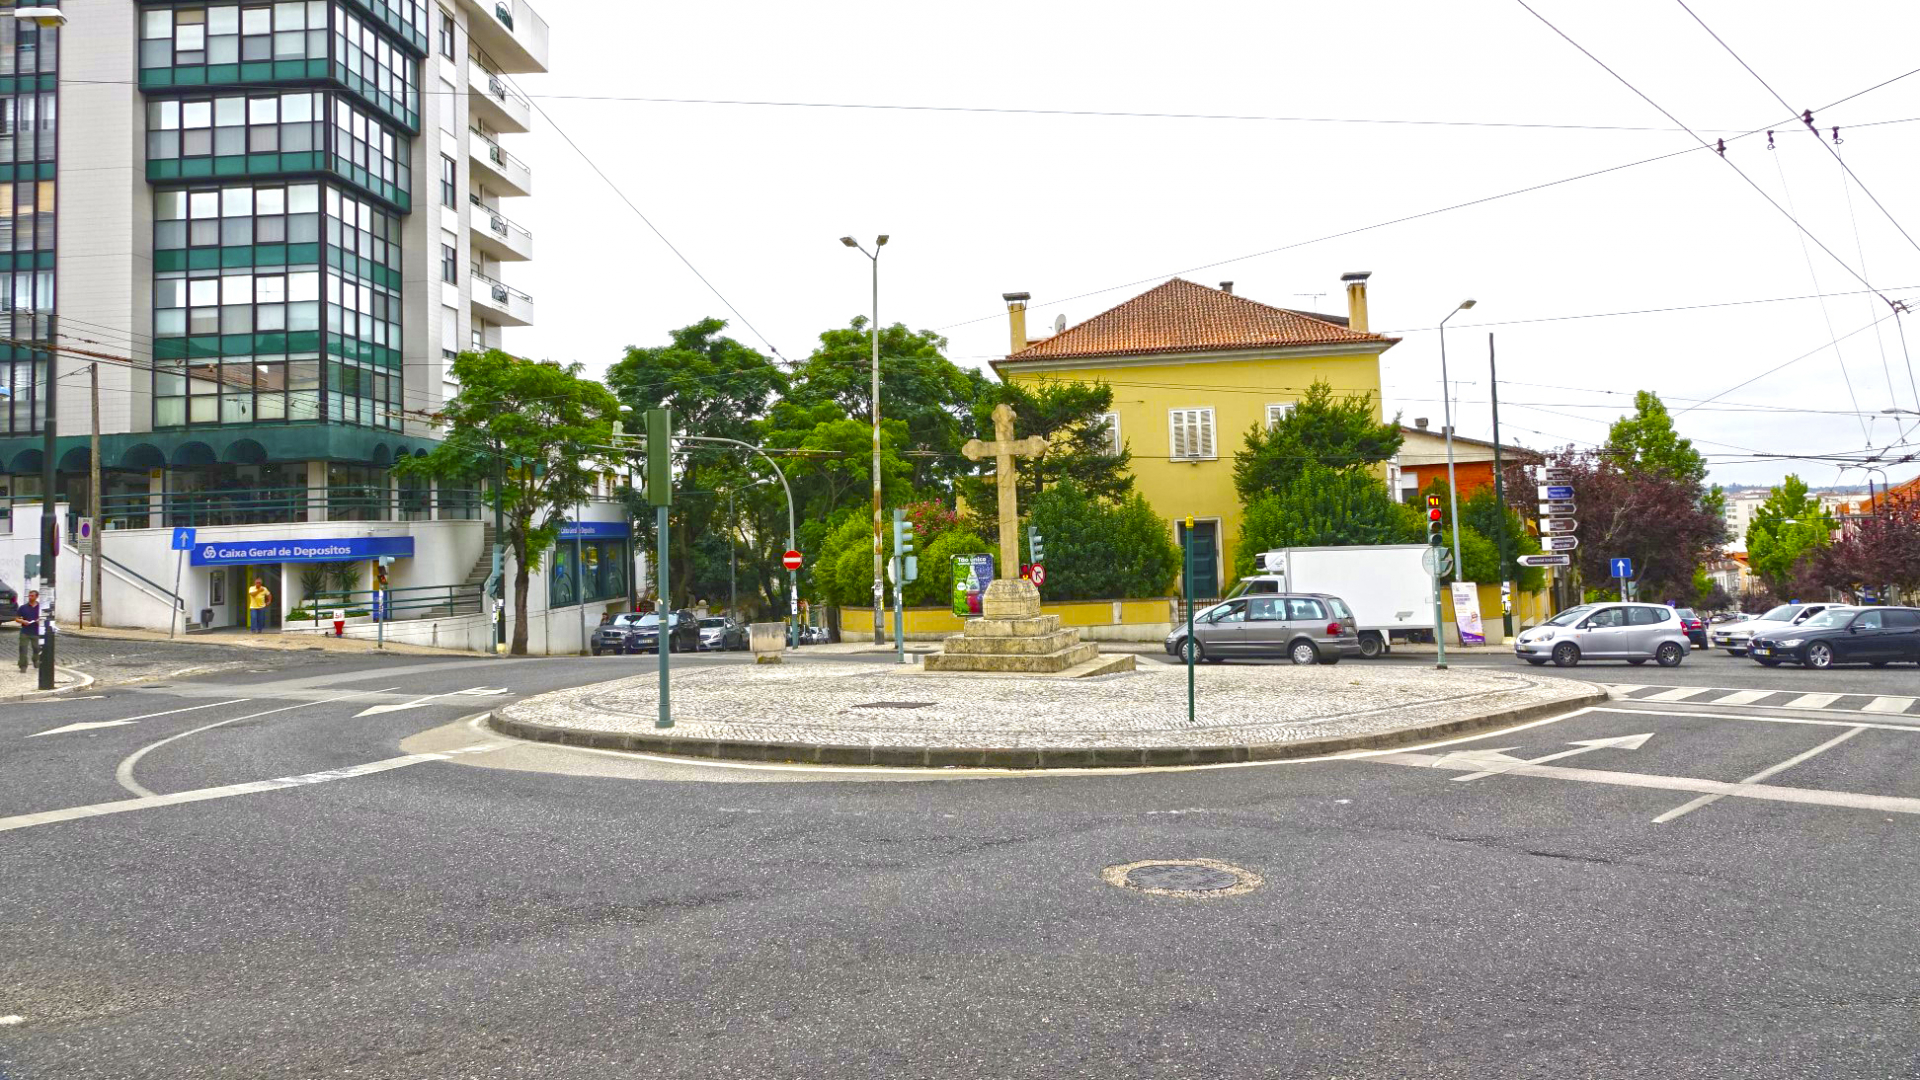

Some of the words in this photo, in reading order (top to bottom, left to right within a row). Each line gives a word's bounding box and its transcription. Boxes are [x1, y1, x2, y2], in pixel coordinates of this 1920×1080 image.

[219, 549, 247, 558] Caixa
[249, 547, 276, 557] Geral
[278, 547, 291, 556] de
